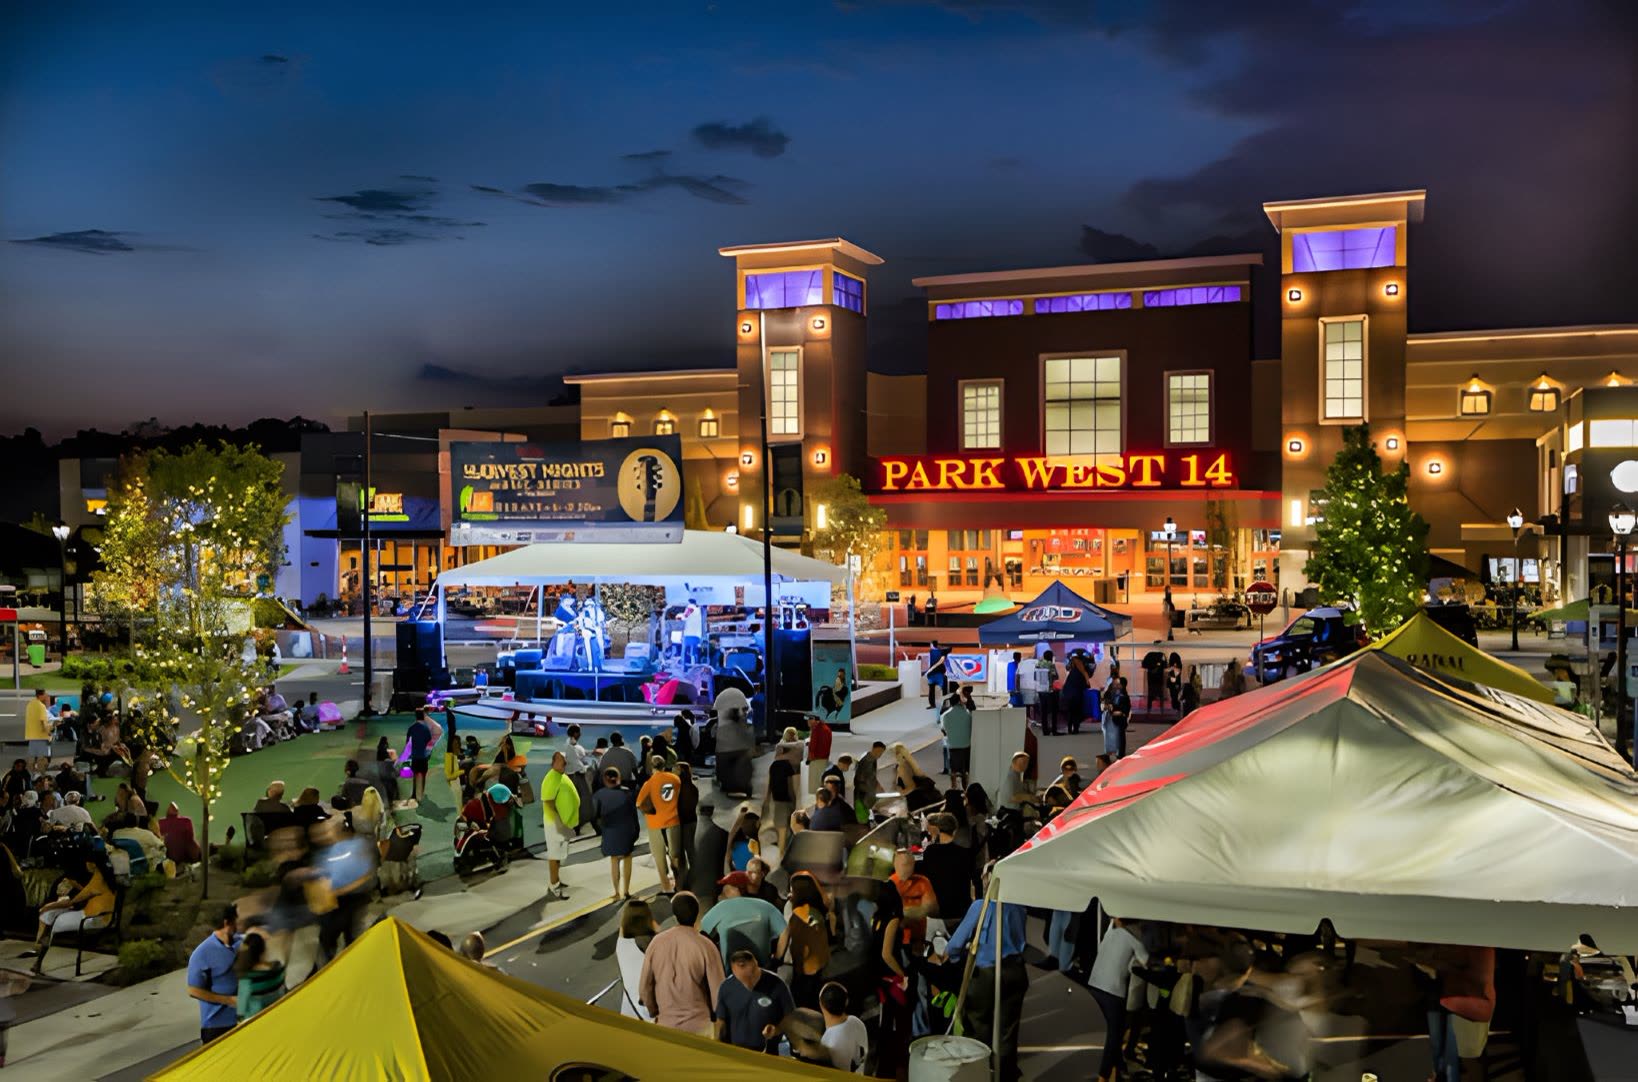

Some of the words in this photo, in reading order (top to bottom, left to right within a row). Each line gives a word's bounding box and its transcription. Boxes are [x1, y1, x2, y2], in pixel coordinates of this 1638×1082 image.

[881, 457, 1006, 491] PARK
[1015, 454, 1165, 489] WEST
[1180, 453, 1233, 487] 14
